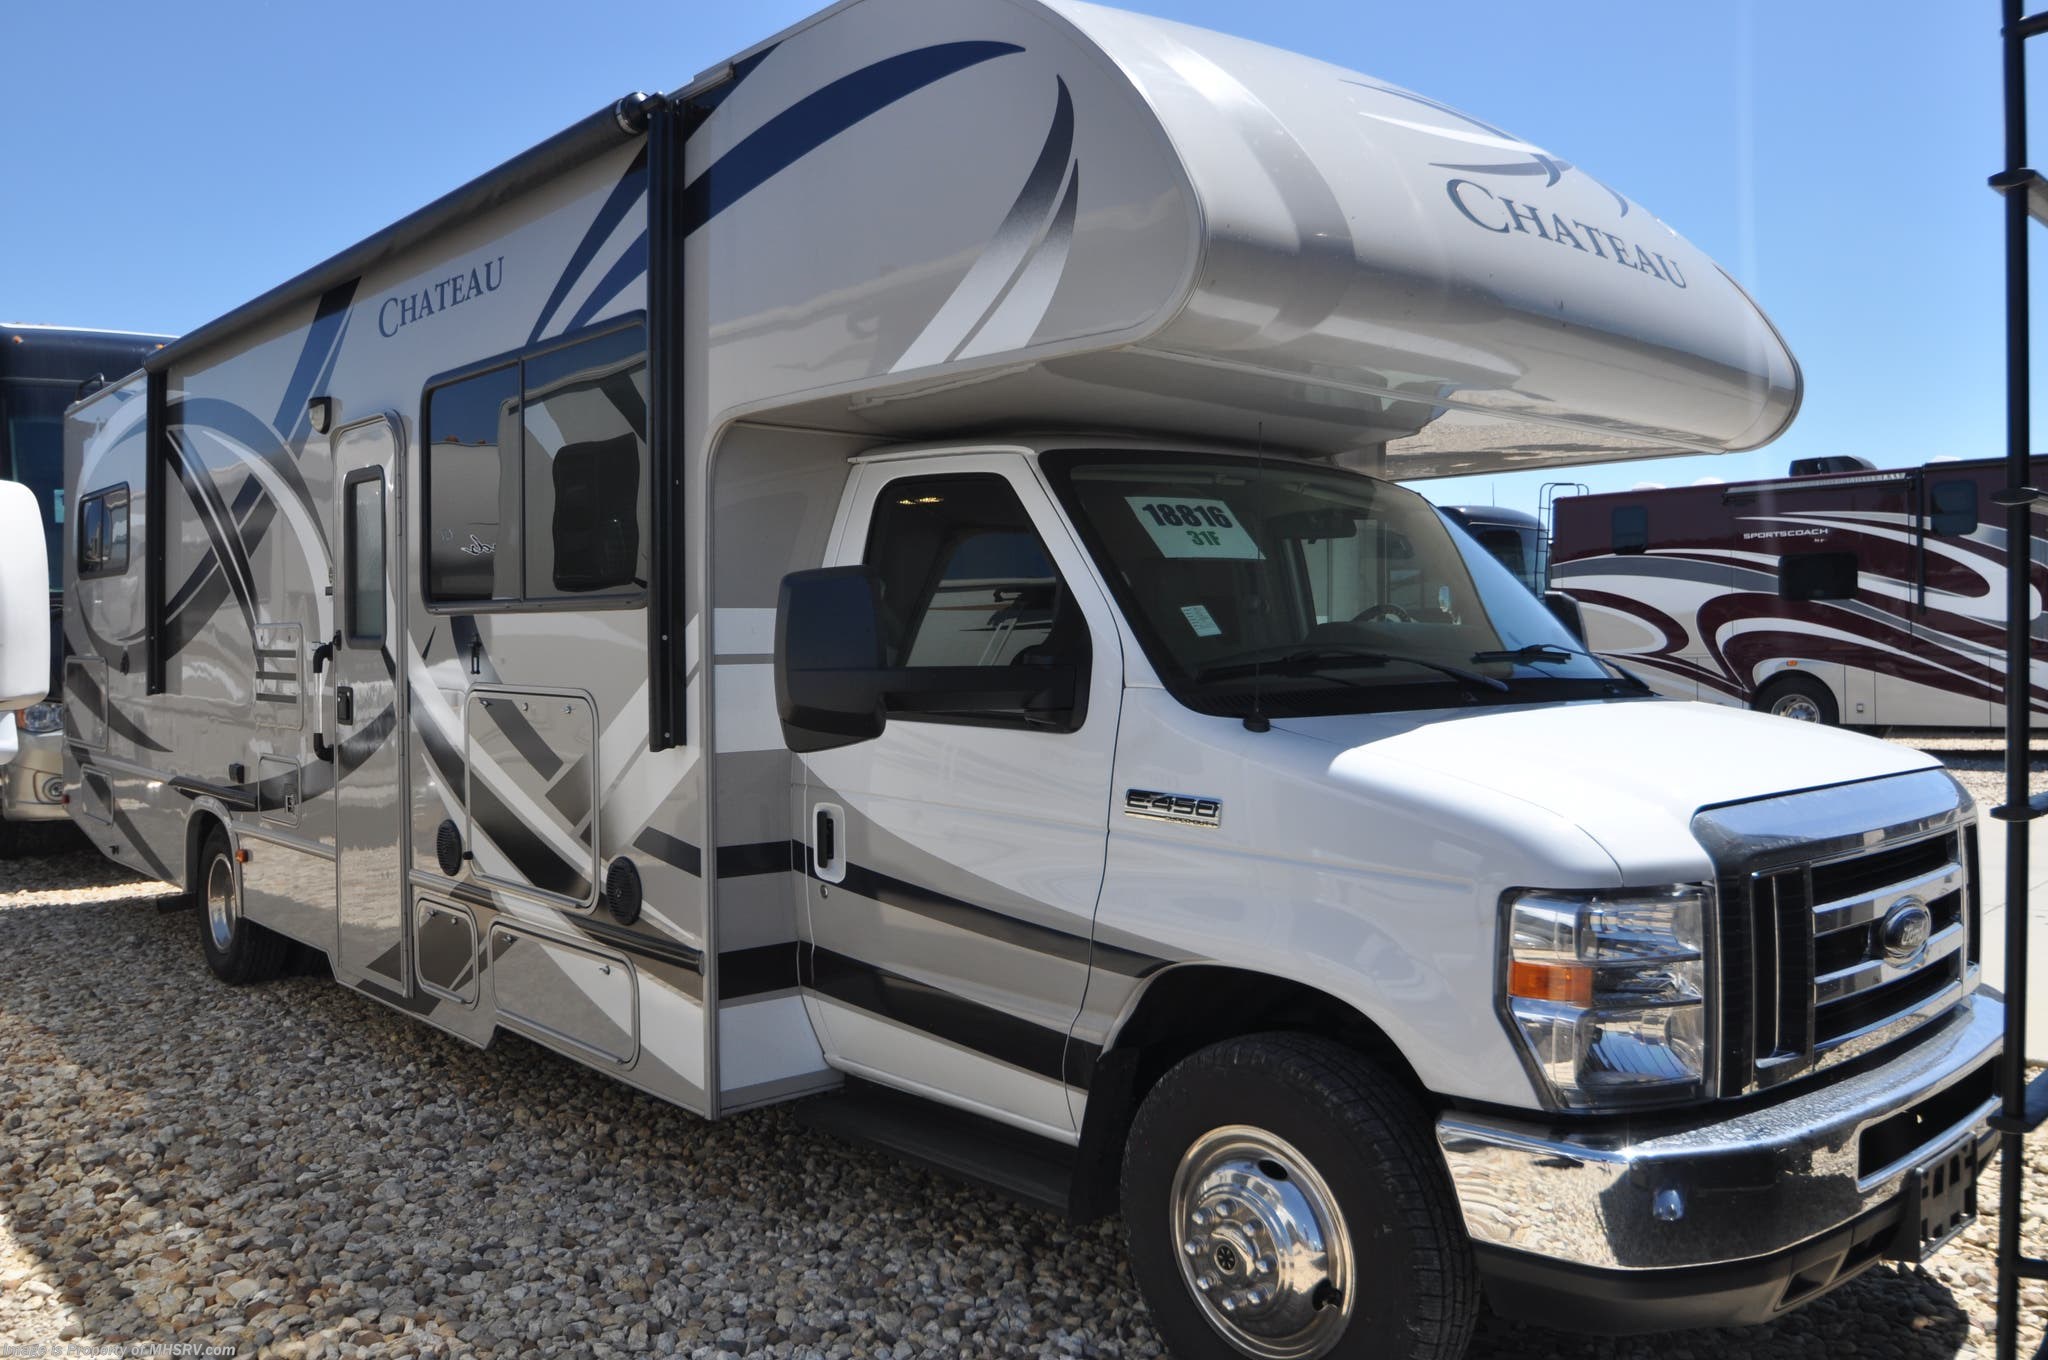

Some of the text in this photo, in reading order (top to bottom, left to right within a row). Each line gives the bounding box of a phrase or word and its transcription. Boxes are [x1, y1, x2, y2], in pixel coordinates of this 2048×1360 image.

[1446, 178, 1687, 289] CHATEAU
[378, 255, 504, 338] CHATEAU
[1142, 503, 1233, 529] 18816
[1185, 530, 1222, 546] 31F
[1743, 528, 1829, 540] SPORTSCOACH
[1127, 790, 1220, 818] E-450
